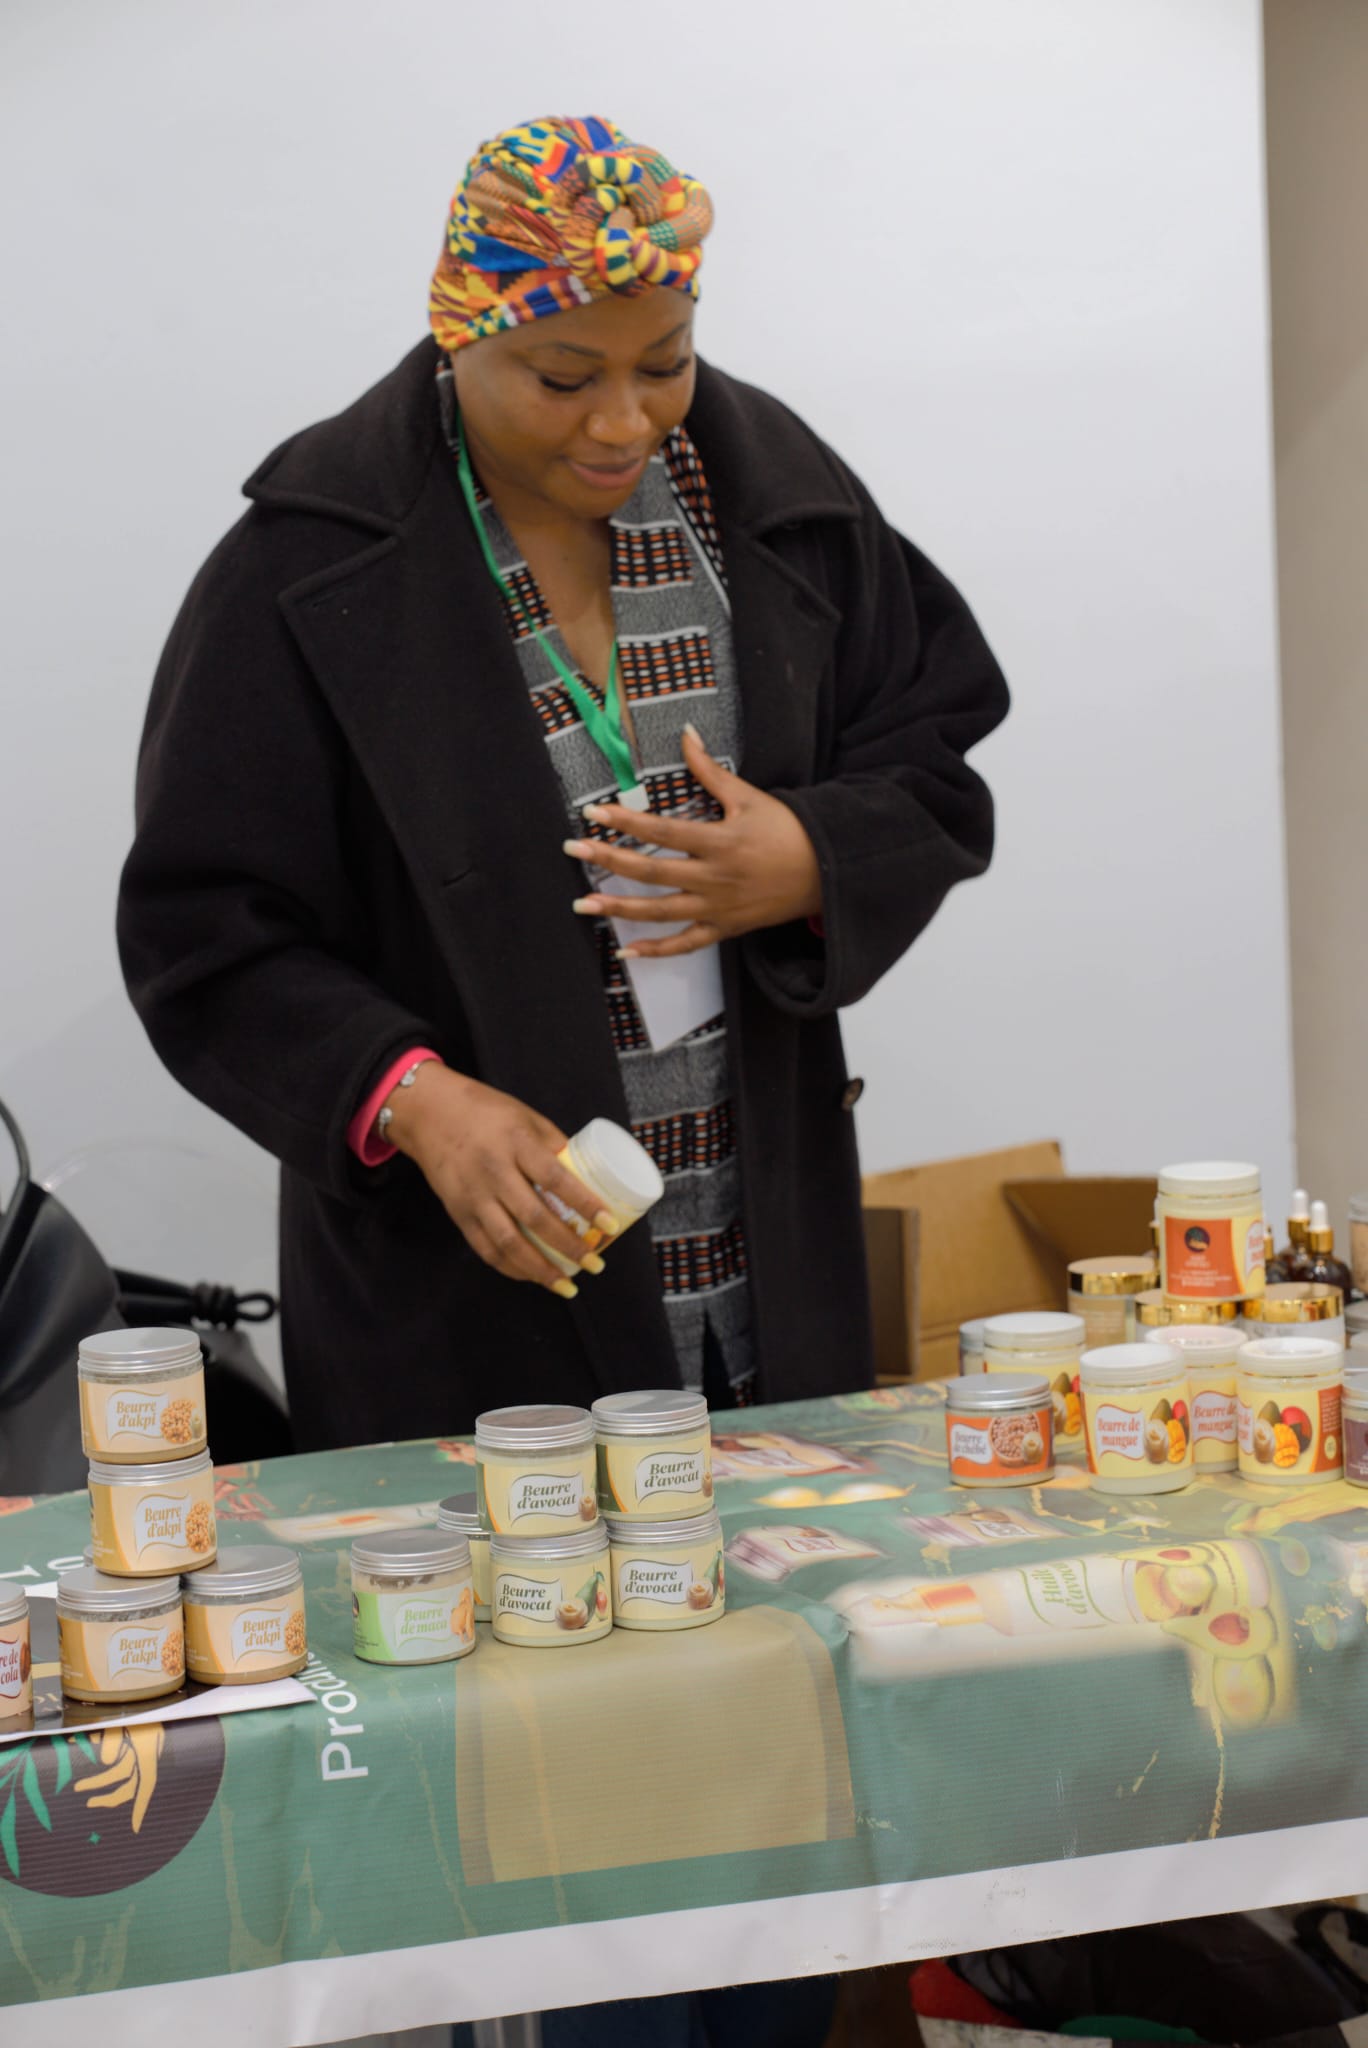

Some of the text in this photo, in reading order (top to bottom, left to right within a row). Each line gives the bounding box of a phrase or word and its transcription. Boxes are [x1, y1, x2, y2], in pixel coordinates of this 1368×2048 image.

[115, 1400, 157, 1415] Beurre
[117, 1412, 157, 1431] d'akpi
[648, 1459, 696, 1476] Beurre
[643, 1469, 700, 1489] d'avocat
[521, 1482, 571, 1498] Beurre
[516, 1492, 577, 1510] d'avocat
[143, 1504, 182, 1523] Beurre
[146, 1520, 182, 1540] d'akpi
[628, 1568, 678, 1582] Beurre
[501, 1584, 547, 1599] Beurre
[624, 1579, 684, 1595] d'avocat
[498, 1595, 552, 1611] d'avocat
[404, 1607, 443, 1621] Beurre
[242, 1616, 281, 1634] Beurre
[400, 1620, 415, 1635] de
[119, 1636, 159, 1652] Beurre
[245, 1629, 281, 1647] d'akpi
[120, 1646, 159, 1666] d'akpi
